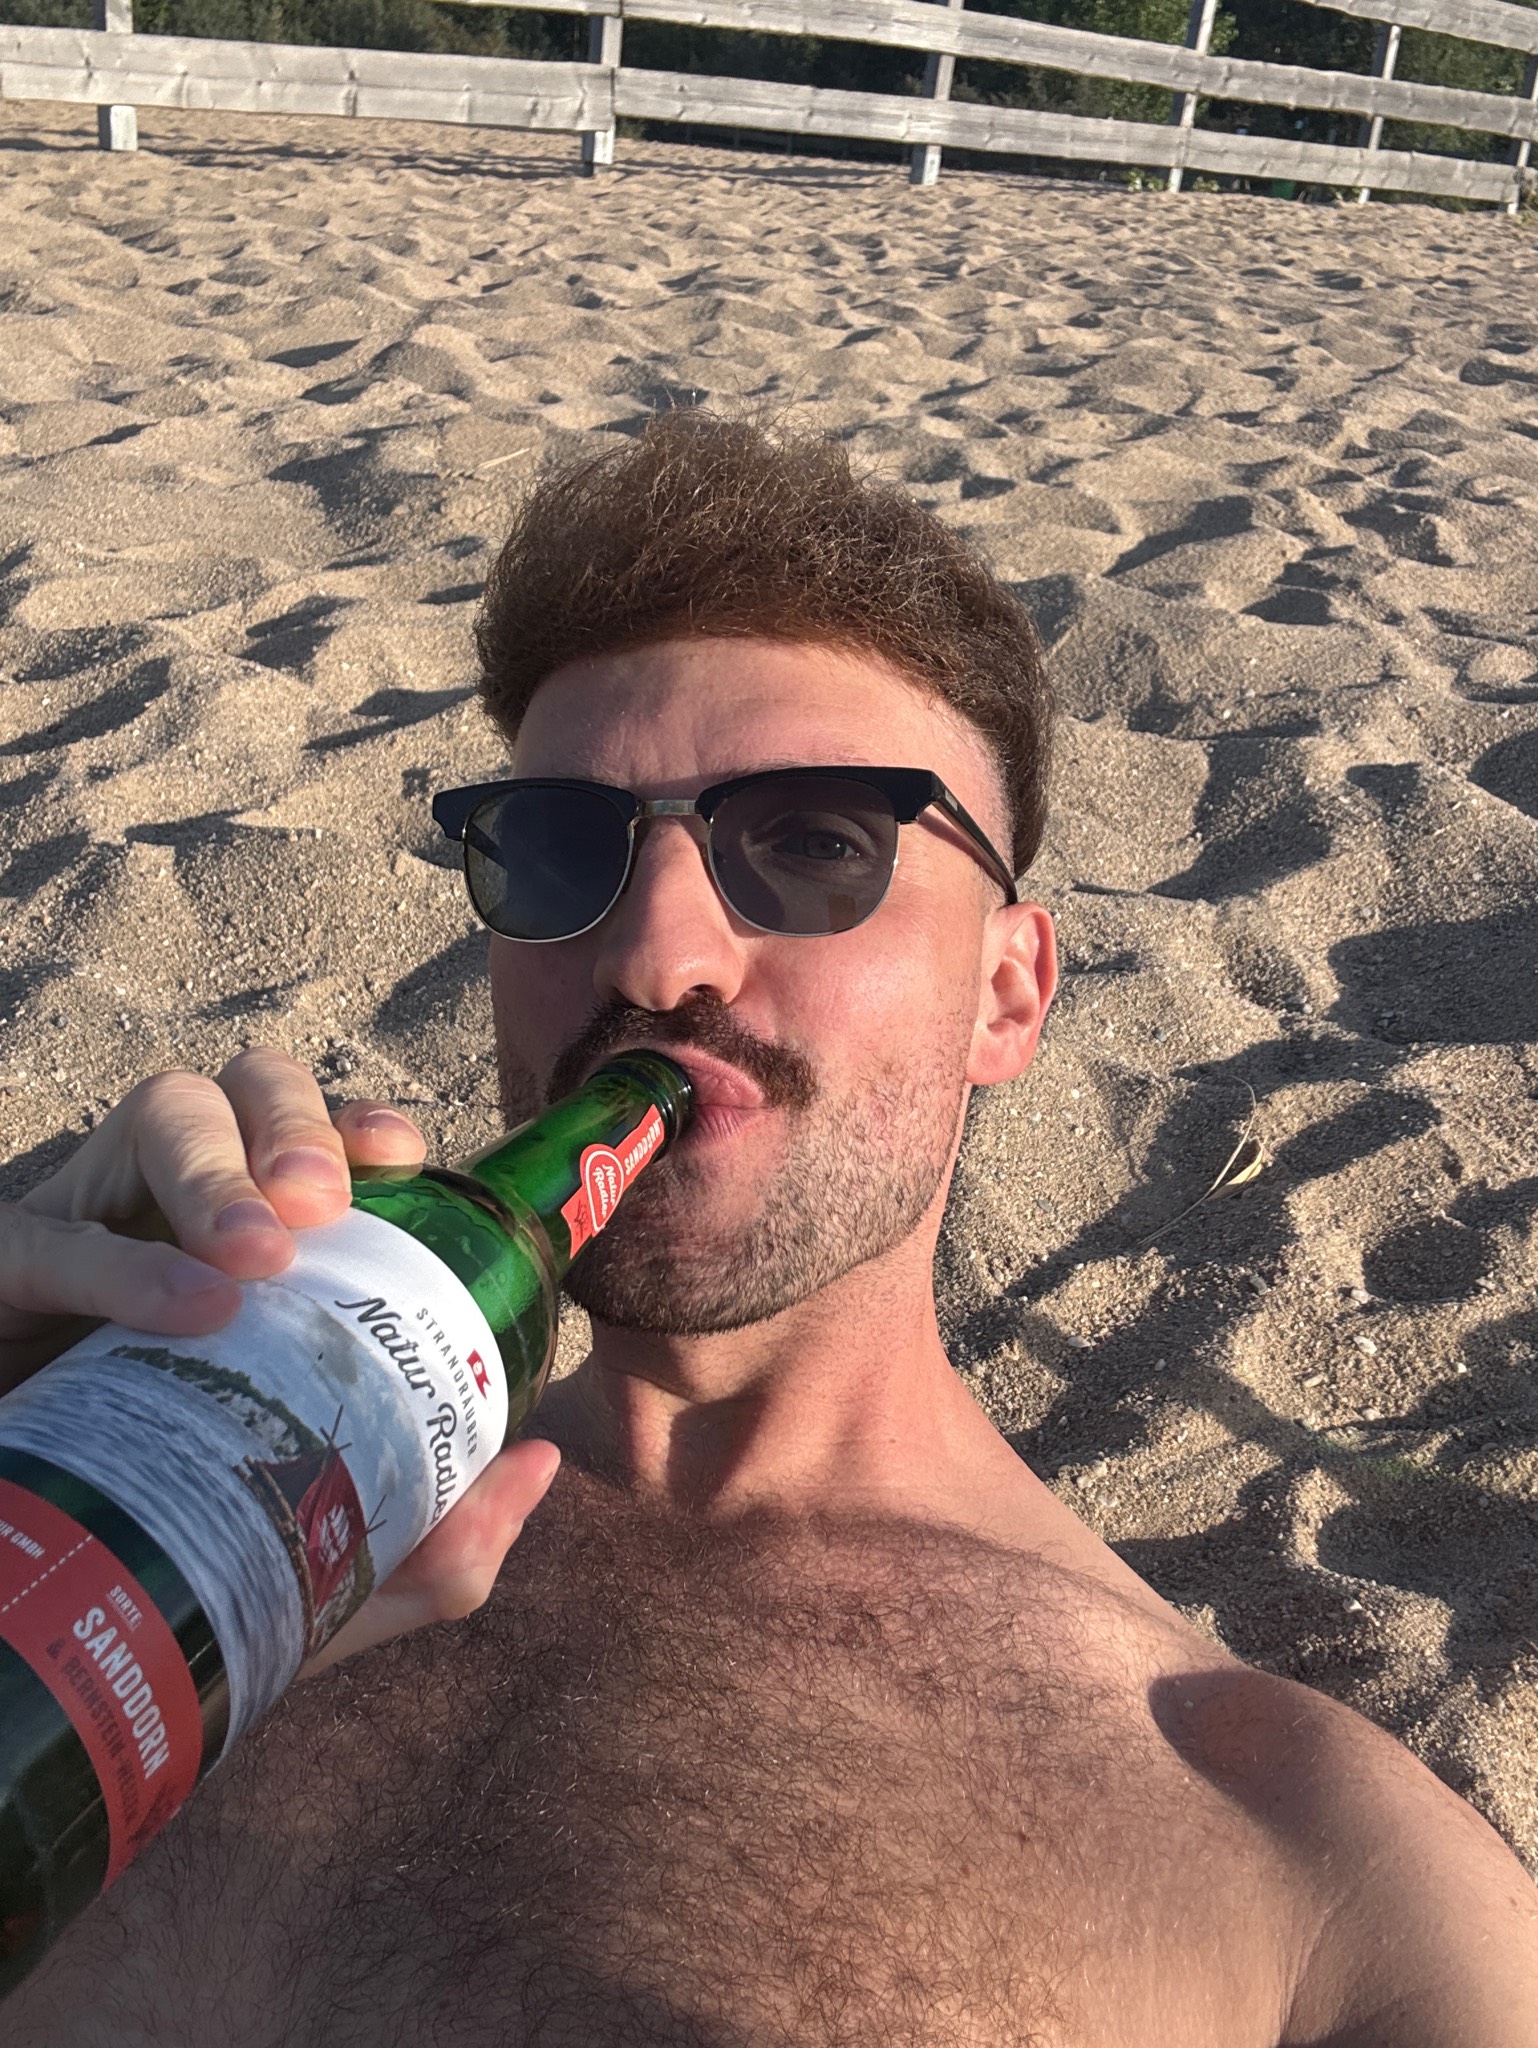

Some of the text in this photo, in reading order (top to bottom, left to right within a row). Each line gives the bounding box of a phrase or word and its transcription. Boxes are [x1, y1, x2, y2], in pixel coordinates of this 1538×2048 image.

[592, 1167, 608, 1218] Radler
[602, 1164, 617, 1206] Natur
[334, 1297, 457, 1526] Natur Radle
[416, 1307, 478, 1459] STRANDRÄUBER
[73, 1607, 171, 1780] SANDDORN
